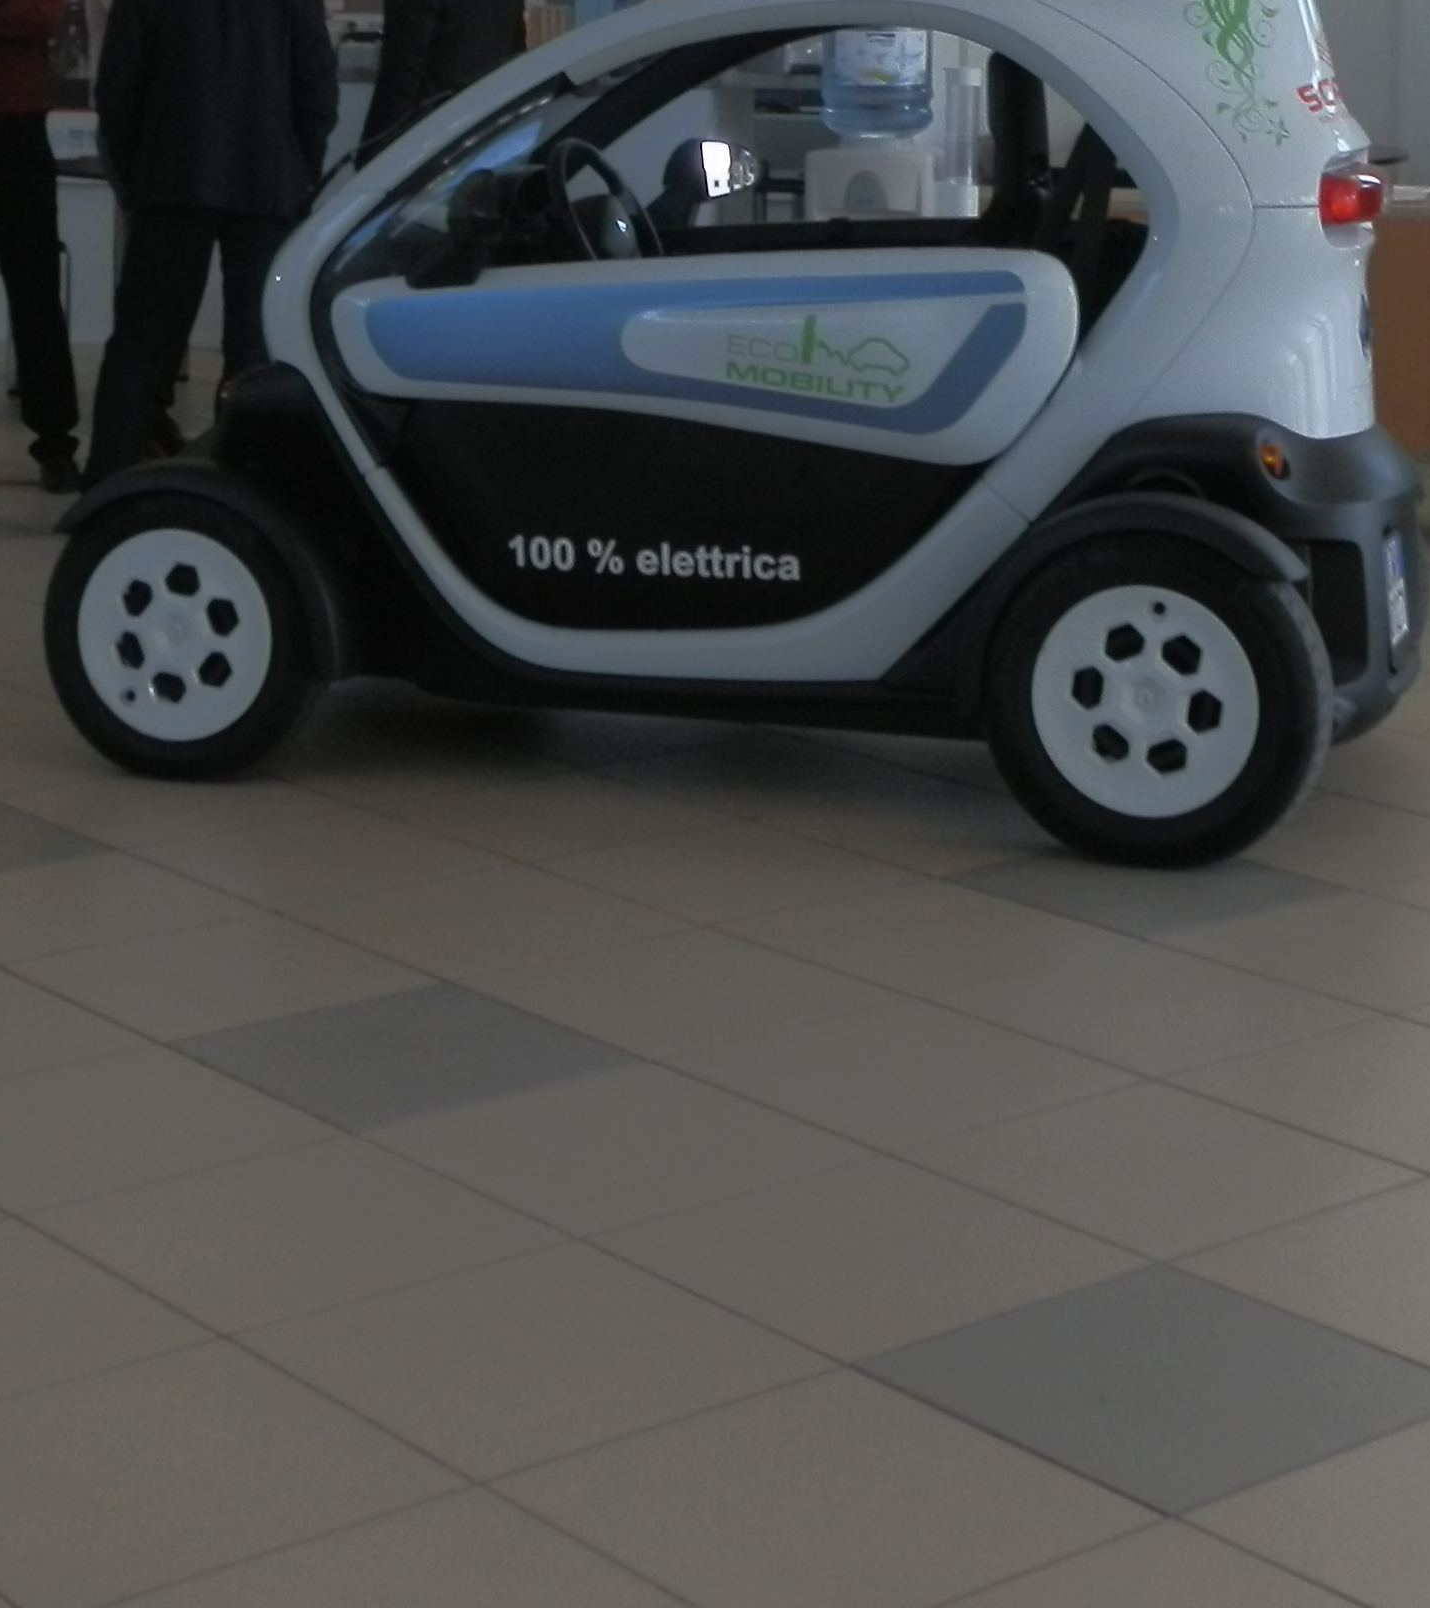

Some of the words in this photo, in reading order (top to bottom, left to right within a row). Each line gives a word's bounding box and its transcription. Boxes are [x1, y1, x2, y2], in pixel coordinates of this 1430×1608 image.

[1296, 77, 1344, 114] SC
[726, 333, 800, 365] ECO
[725, 360, 908, 405] MOBILITY
[508, 533, 573, 573] 100
[586, 537, 625, 576] %
[634, 541, 801, 582] elettrica
